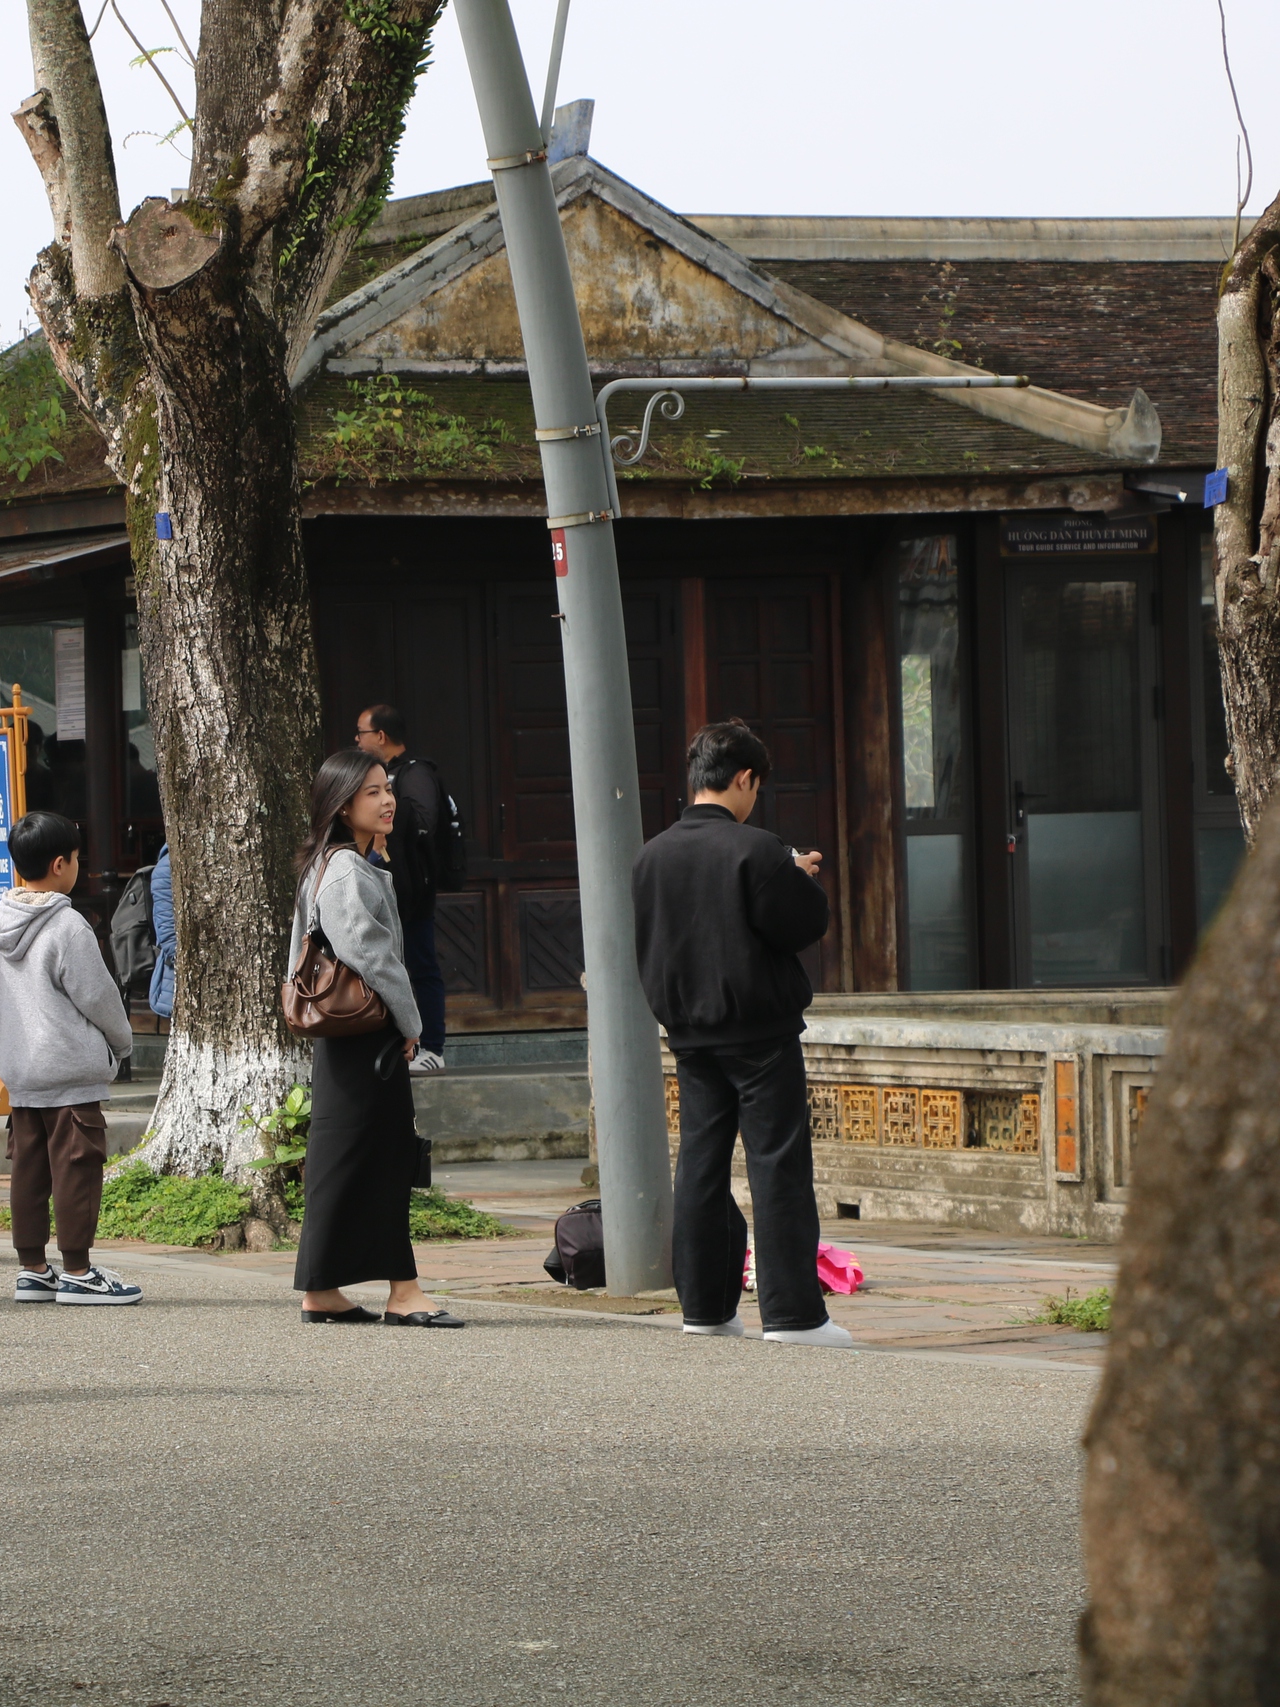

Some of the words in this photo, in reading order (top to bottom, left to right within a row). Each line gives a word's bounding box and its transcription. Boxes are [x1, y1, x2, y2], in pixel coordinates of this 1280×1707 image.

[1119, 528, 1147, 538] MINH
[1056, 542, 1081, 550] SERVICE
[1098, 542, 1138, 550] INFORMATION
